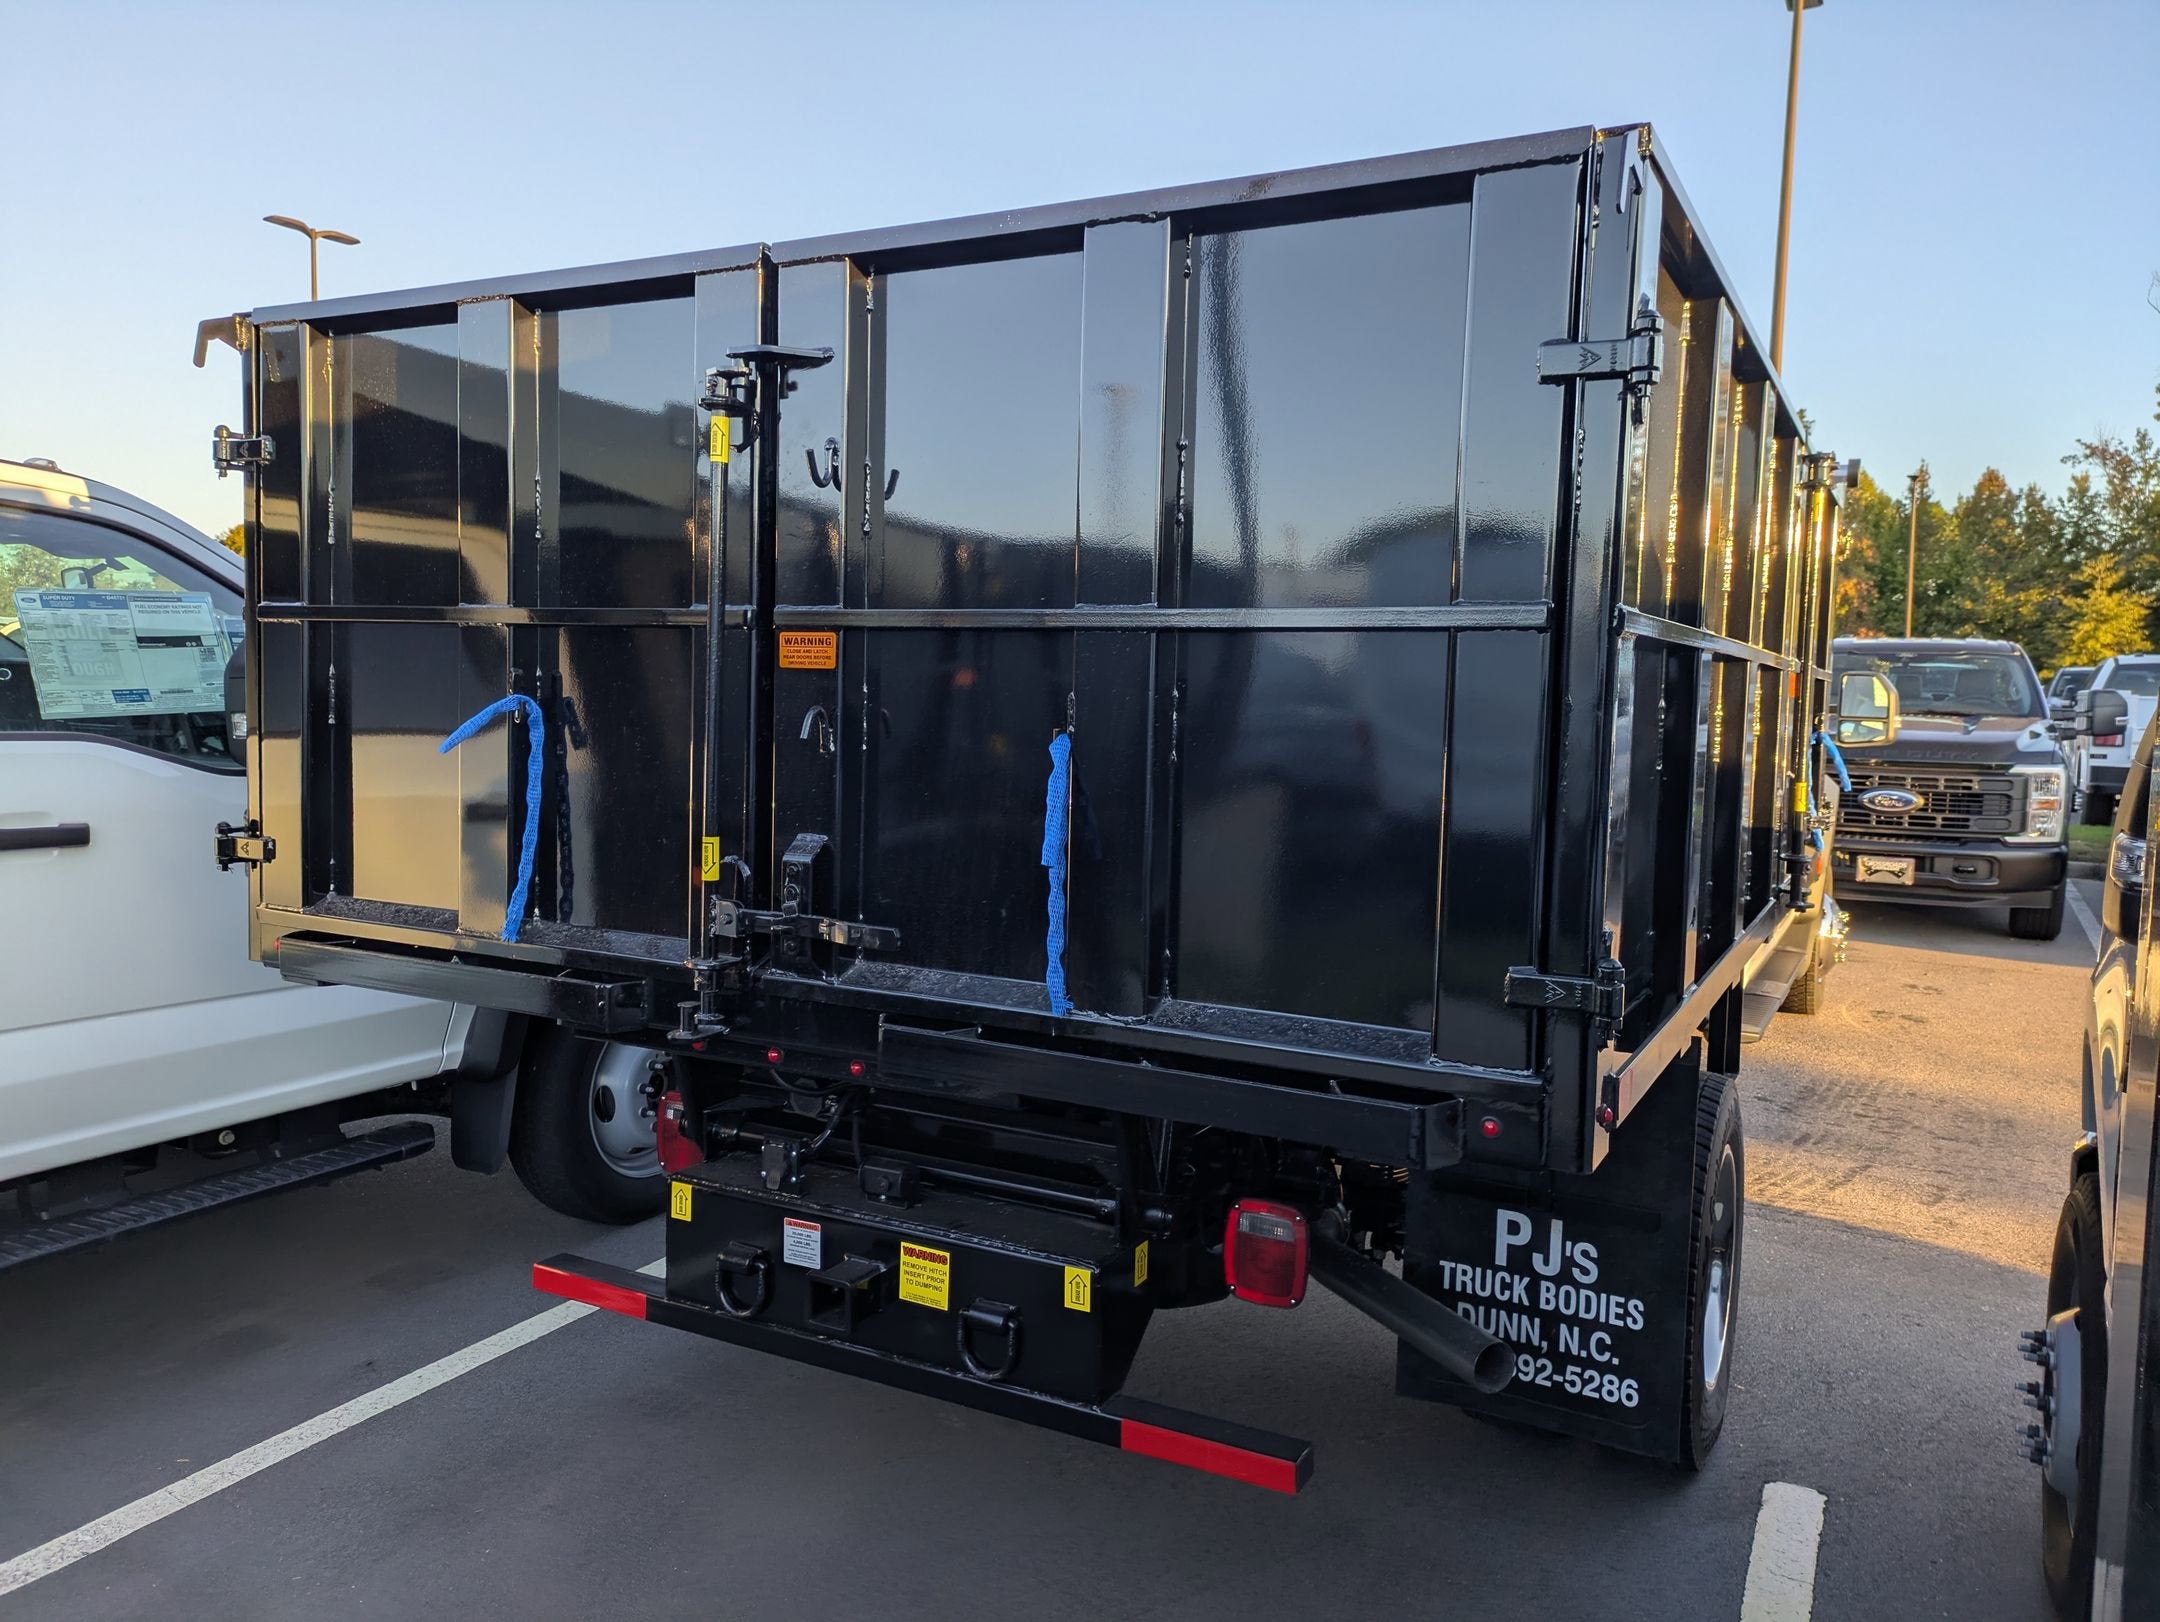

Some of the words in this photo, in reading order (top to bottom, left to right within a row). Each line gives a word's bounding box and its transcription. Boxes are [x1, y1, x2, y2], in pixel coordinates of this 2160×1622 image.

[784, 637, 832, 646] WARNING
[902, 1245, 948, 1266] WARNING
[903, 1261, 928, 1272] REMOVE
[929, 1267, 947, 1277] HITCH
[904, 1269, 925, 1280] INSERT
[926, 1275, 945, 1285] PRIOR
[915, 1281, 942, 1292] DUMPING
[1439, 1260, 1530, 1306] TRUCK
[1539, 1280, 1645, 1331] BODIES
[1456, 1301, 1549, 1353] DUNN,
[1559, 1323, 1620, 1365] N.C.
[1511, 1353, 1640, 1408] 92-5286
